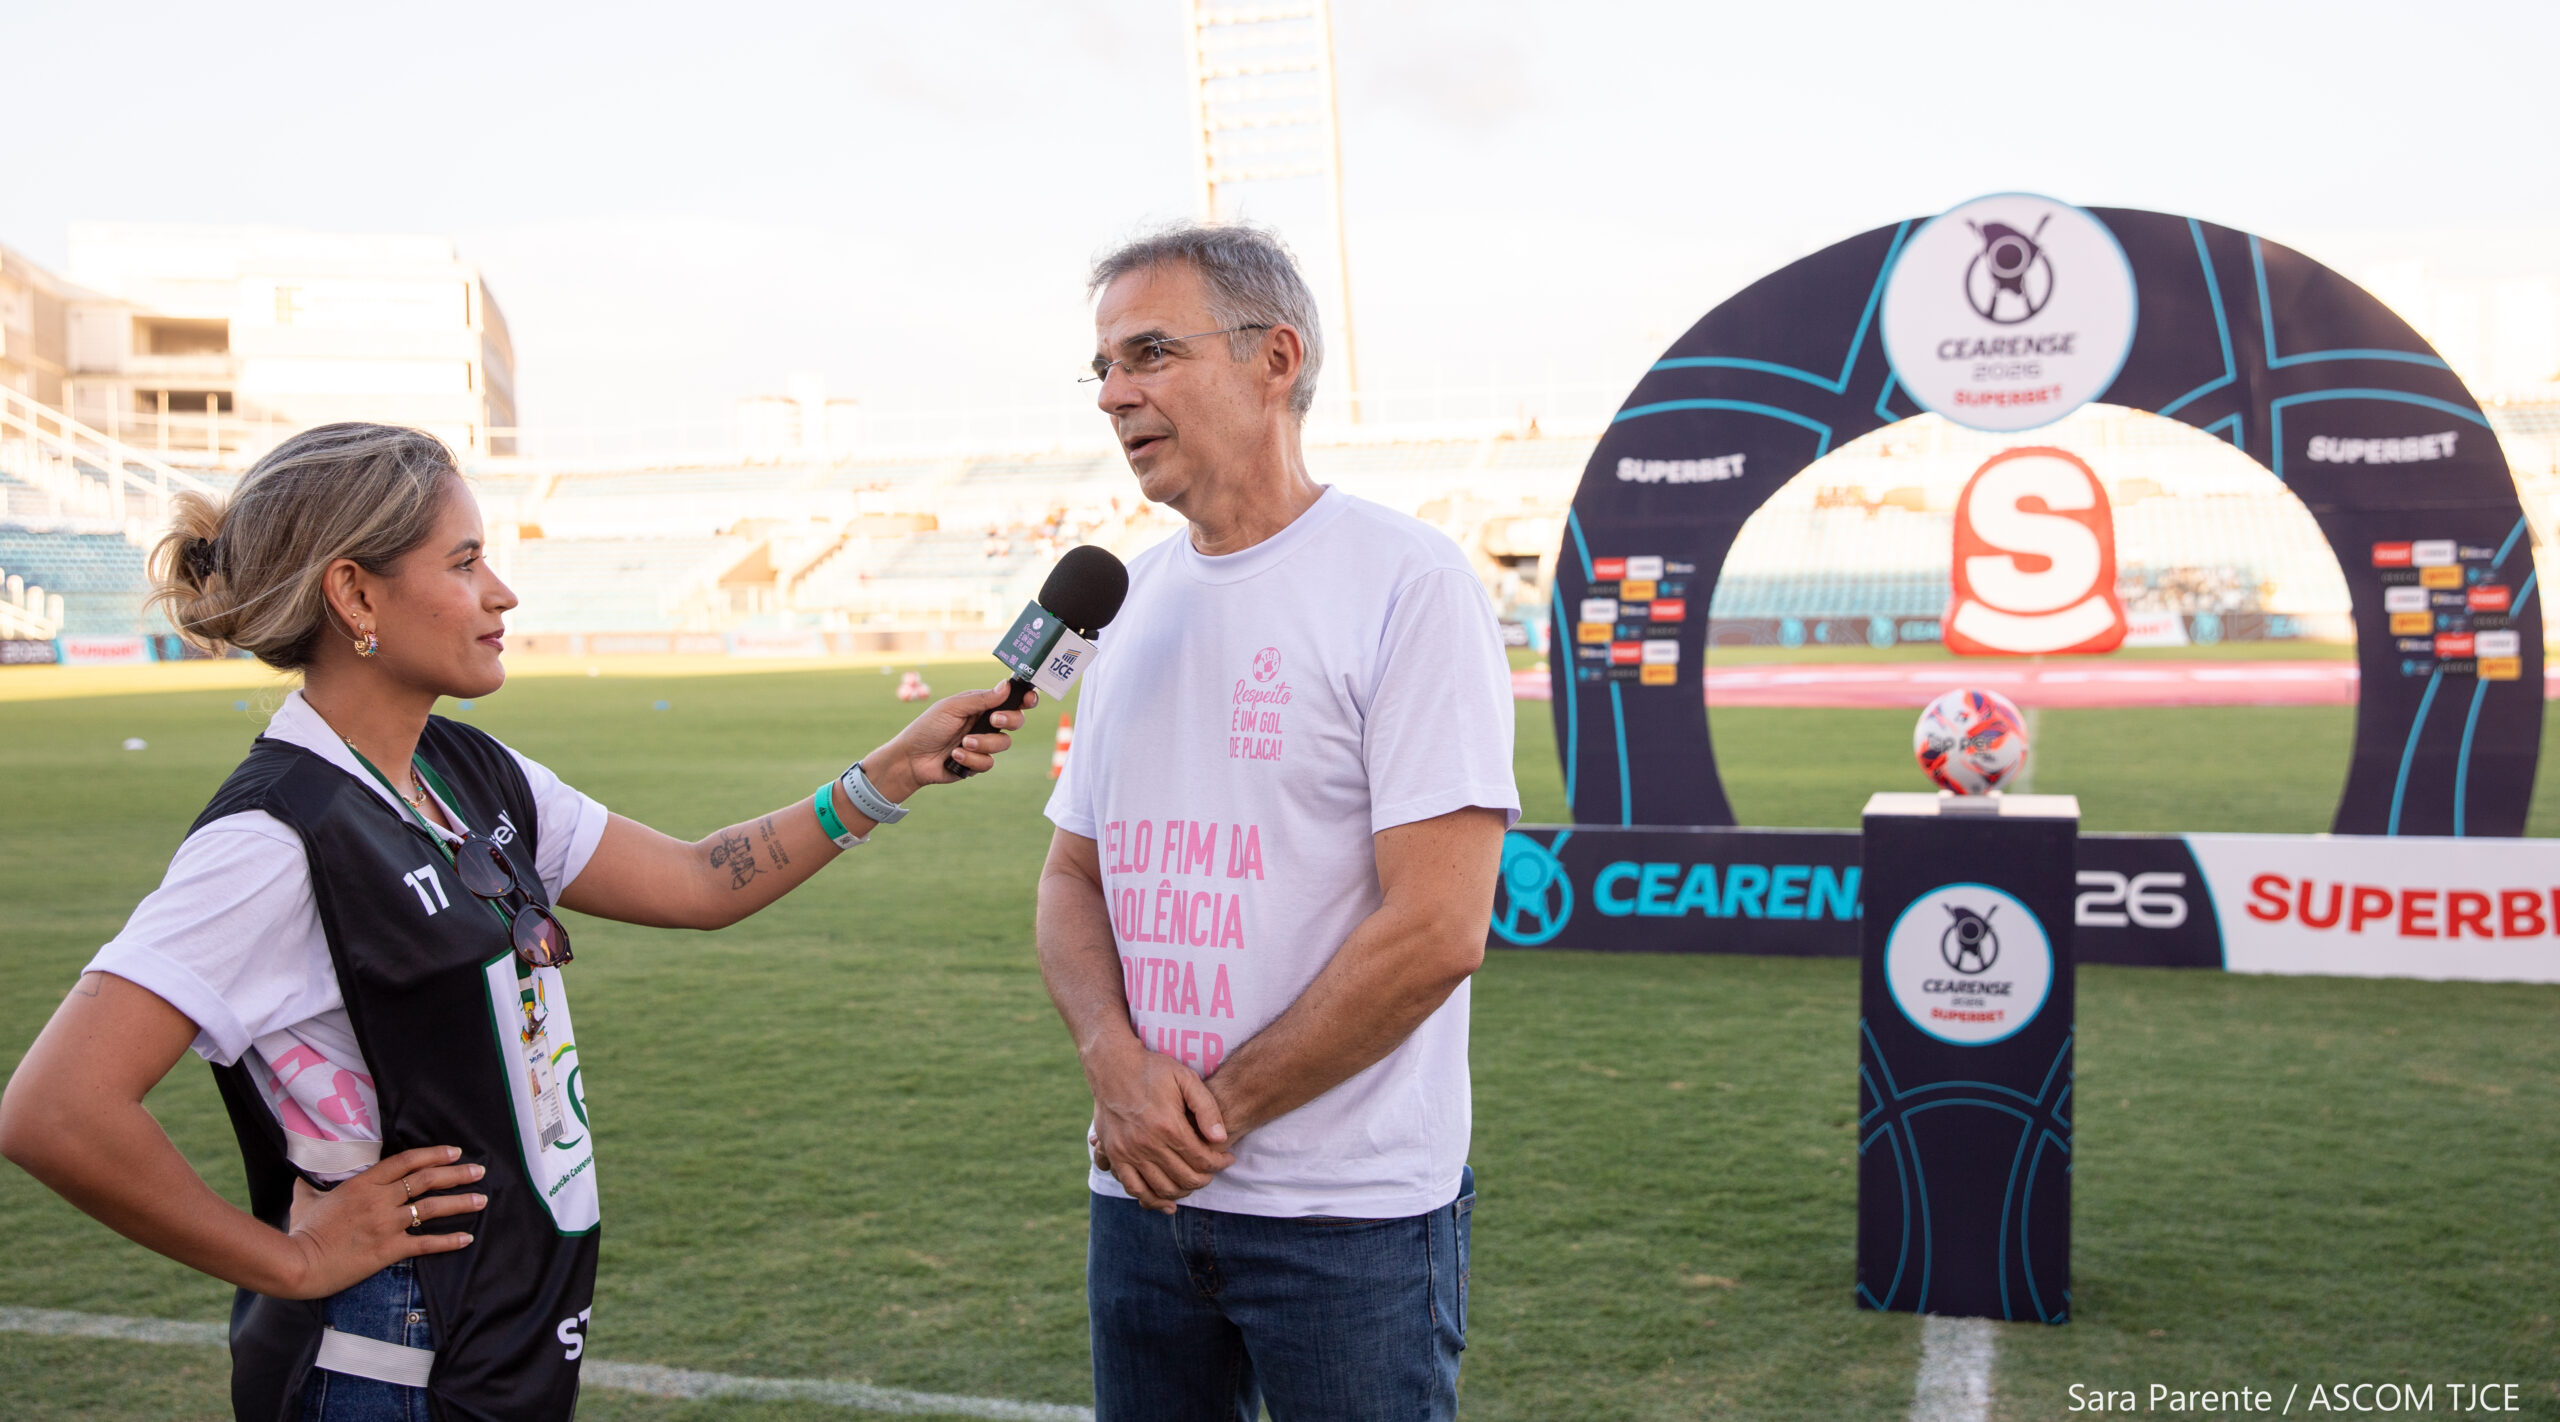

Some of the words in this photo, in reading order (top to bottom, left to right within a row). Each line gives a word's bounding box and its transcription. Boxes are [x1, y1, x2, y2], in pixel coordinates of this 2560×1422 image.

[1937, 332, 2077, 361] CEARENSE
[1973, 362, 2042, 381] 2026
[1954, 383, 2064, 407] SUPERBET
[2307, 431, 2459, 464] SUPERBET
[1617, 454, 1747, 484] SUPERBET
[1050, 658, 1074, 679] TJCE
[1232, 679, 1293, 711] Respeito
[1232, 706, 1240, 732] É
[1240, 710, 1258, 732] UM
[1259, 711, 1283, 734] GOL
[1229, 736, 1241, 759] DE
[1242, 736, 1283, 761] PLACA!
[1160, 820, 1218, 877] FIM
[1226, 823, 1265, 881] DA
[403, 863, 450, 916] 17
[1593, 860, 1864, 921] CEAREN
[2244, 872, 2560, 941] SUPERB
[1209, 963, 1235, 1019] A
[1922, 979, 2013, 996] CEARENSE
[1931, 1007, 2004, 1022] SUPERBET
